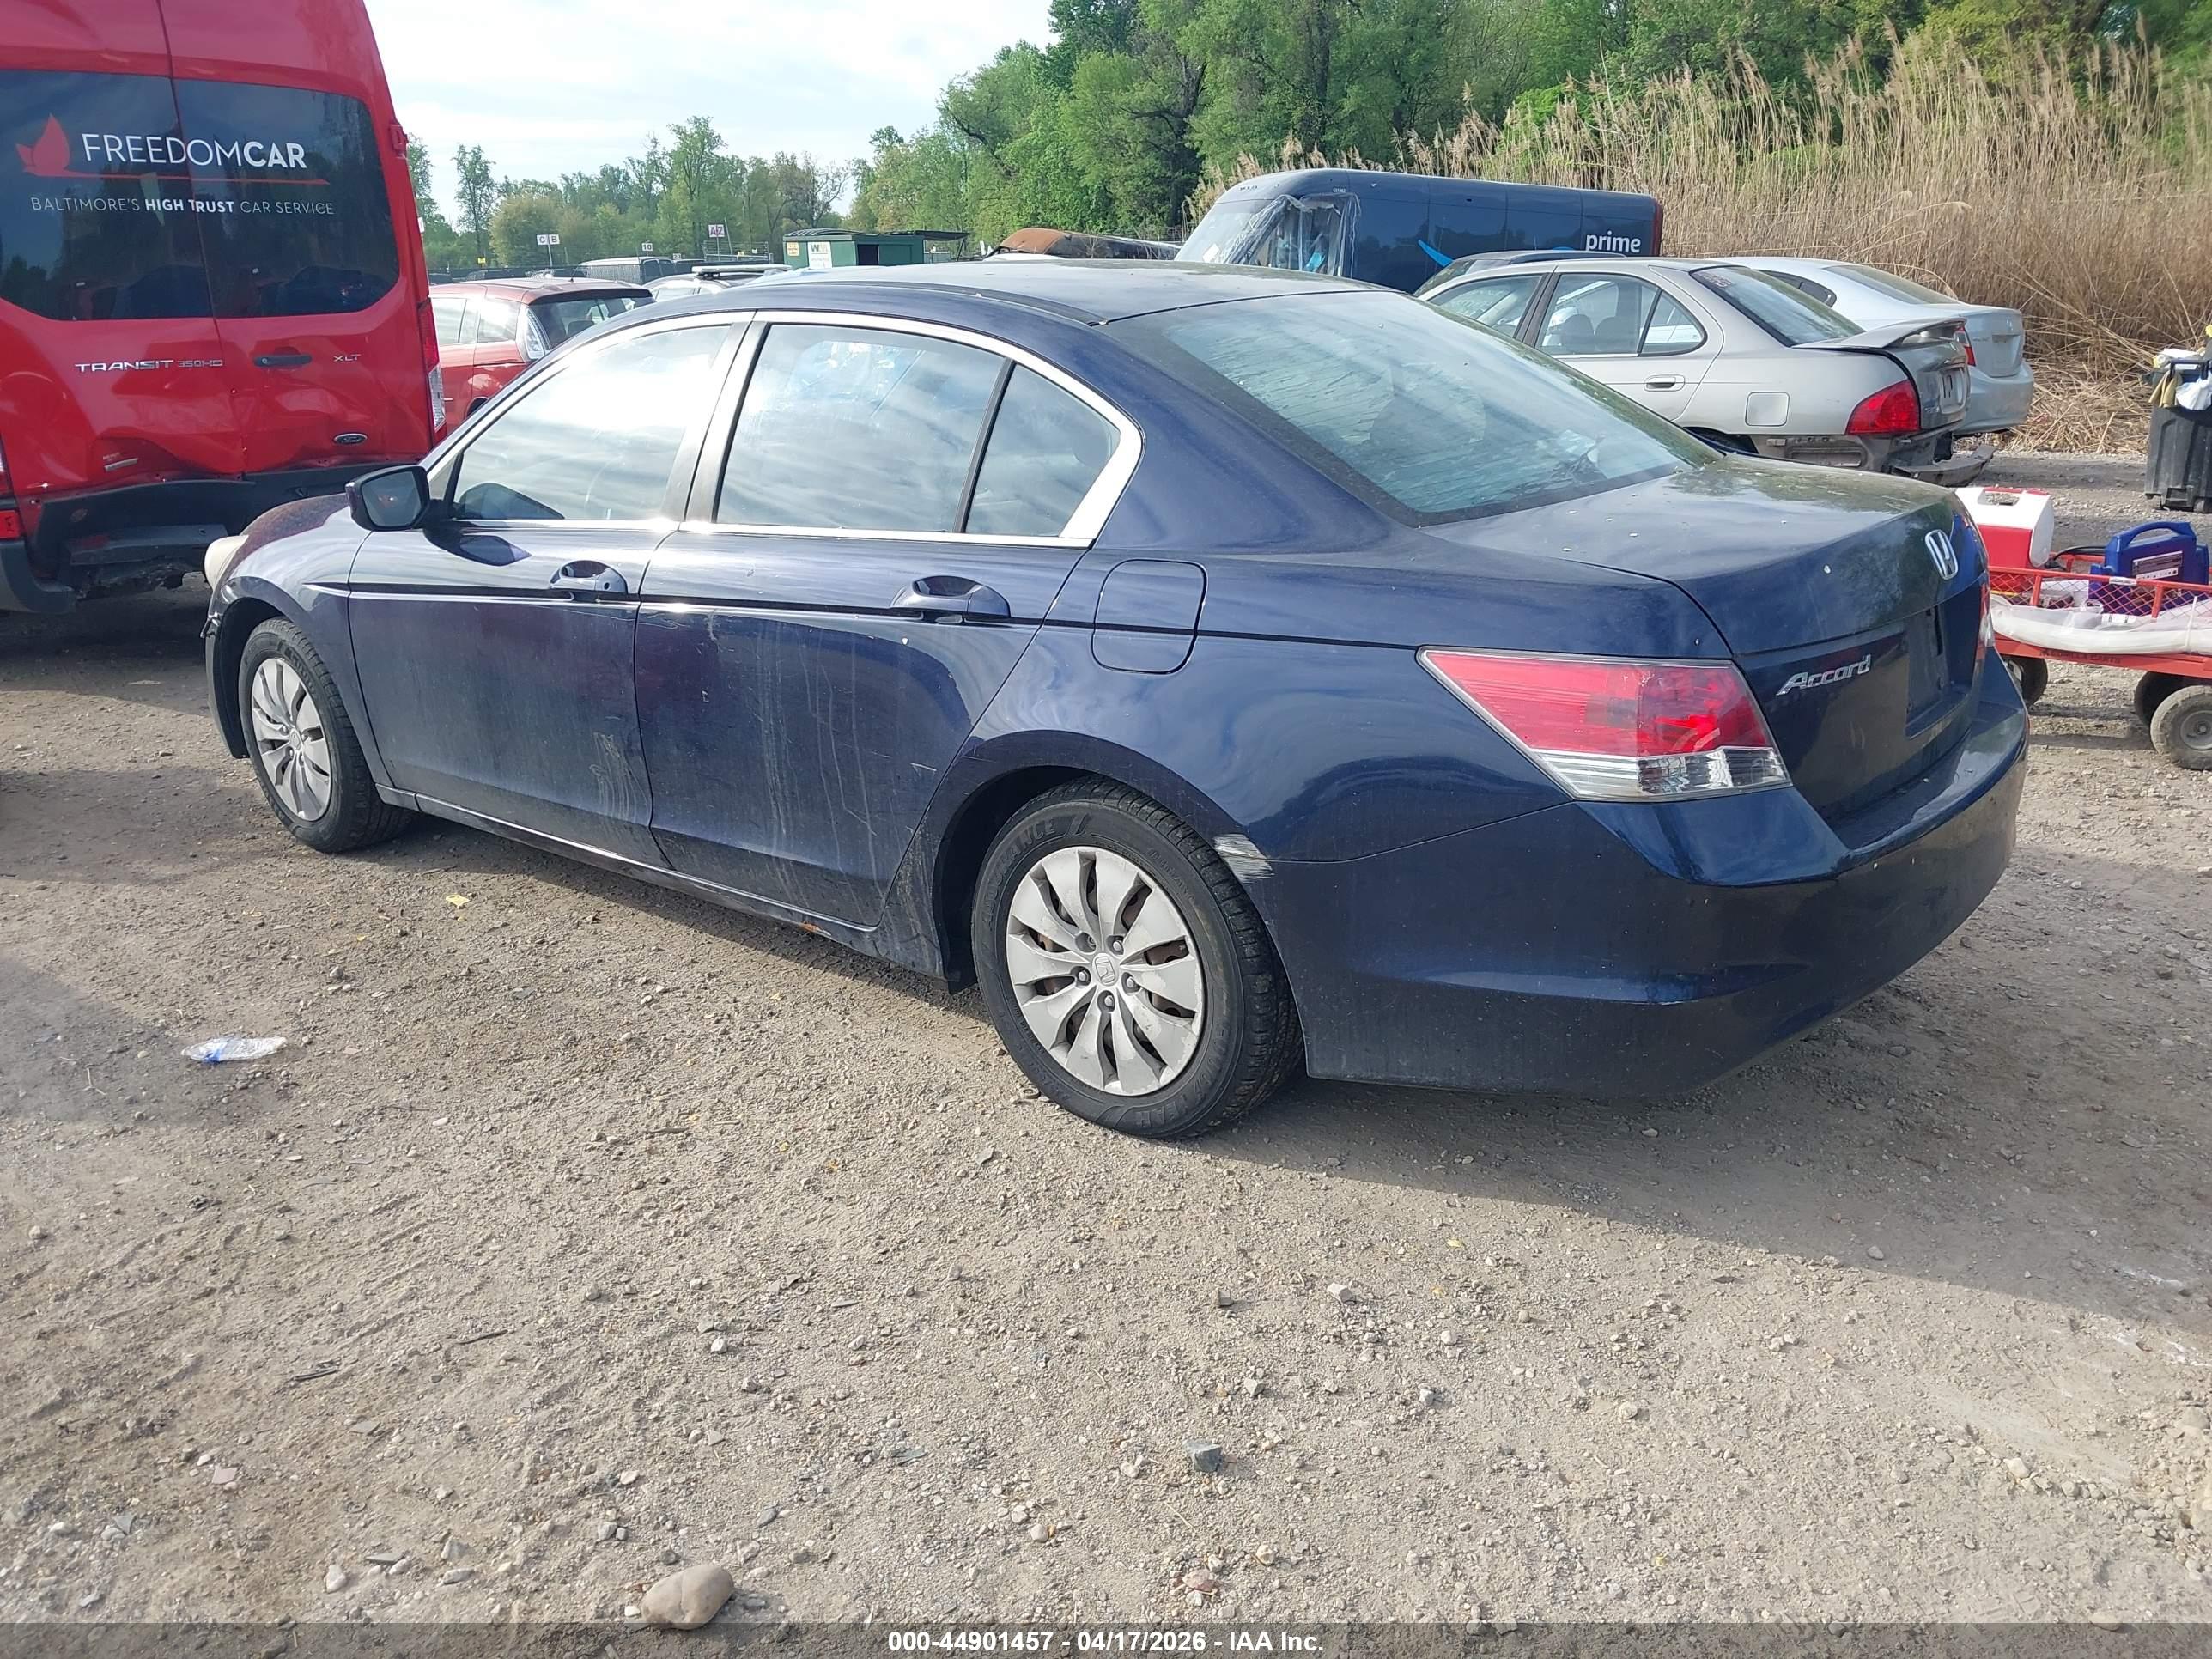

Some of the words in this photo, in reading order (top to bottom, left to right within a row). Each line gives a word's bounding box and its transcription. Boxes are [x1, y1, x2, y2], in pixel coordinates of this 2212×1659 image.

[82, 133, 307, 168] FREEDOMCAR
[31, 198, 140, 211] BALTIMORE'S
[145, 198, 184, 211] HIGH
[188, 199, 234, 213] TRUST
[240, 201, 270, 213] CAR
[276, 201, 334, 215] SERVICE
[1586, 230, 1641, 252] prime
[75, 360, 173, 373] TRANSIT
[334, 353, 361, 362] XLT
[1776, 654, 1871, 696] Accord
